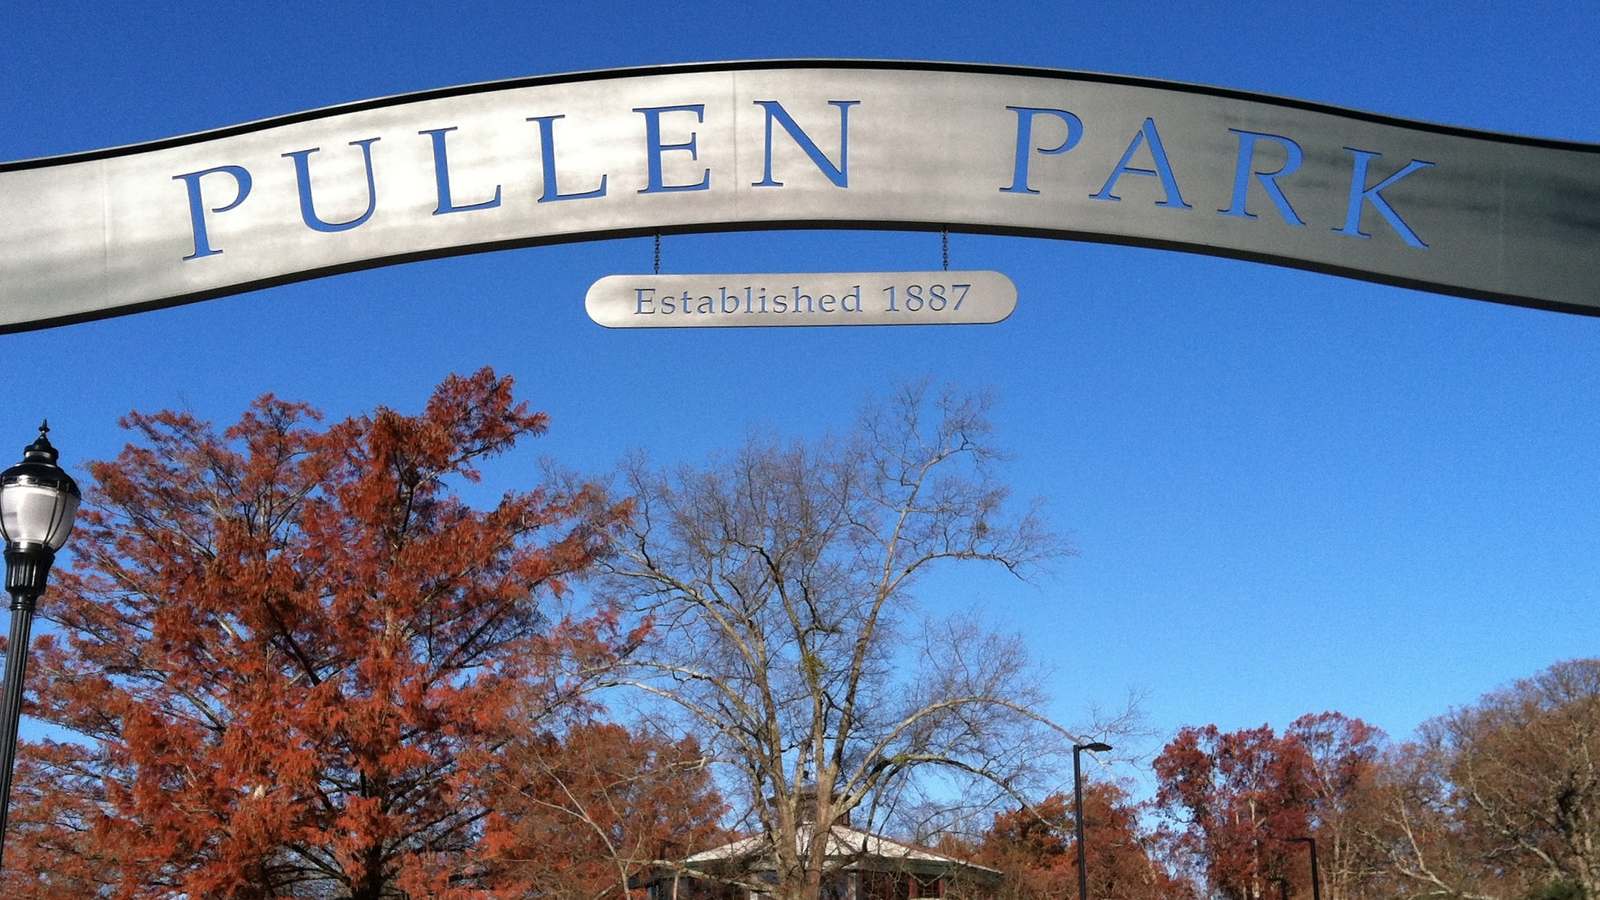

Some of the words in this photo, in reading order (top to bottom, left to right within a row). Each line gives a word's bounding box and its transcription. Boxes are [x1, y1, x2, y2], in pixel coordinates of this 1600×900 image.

[171, 100, 861, 261] PULLEN
[999, 106, 1435, 248] PARK
[633, 285, 863, 315] Established
[883, 283, 971, 312] 1887
